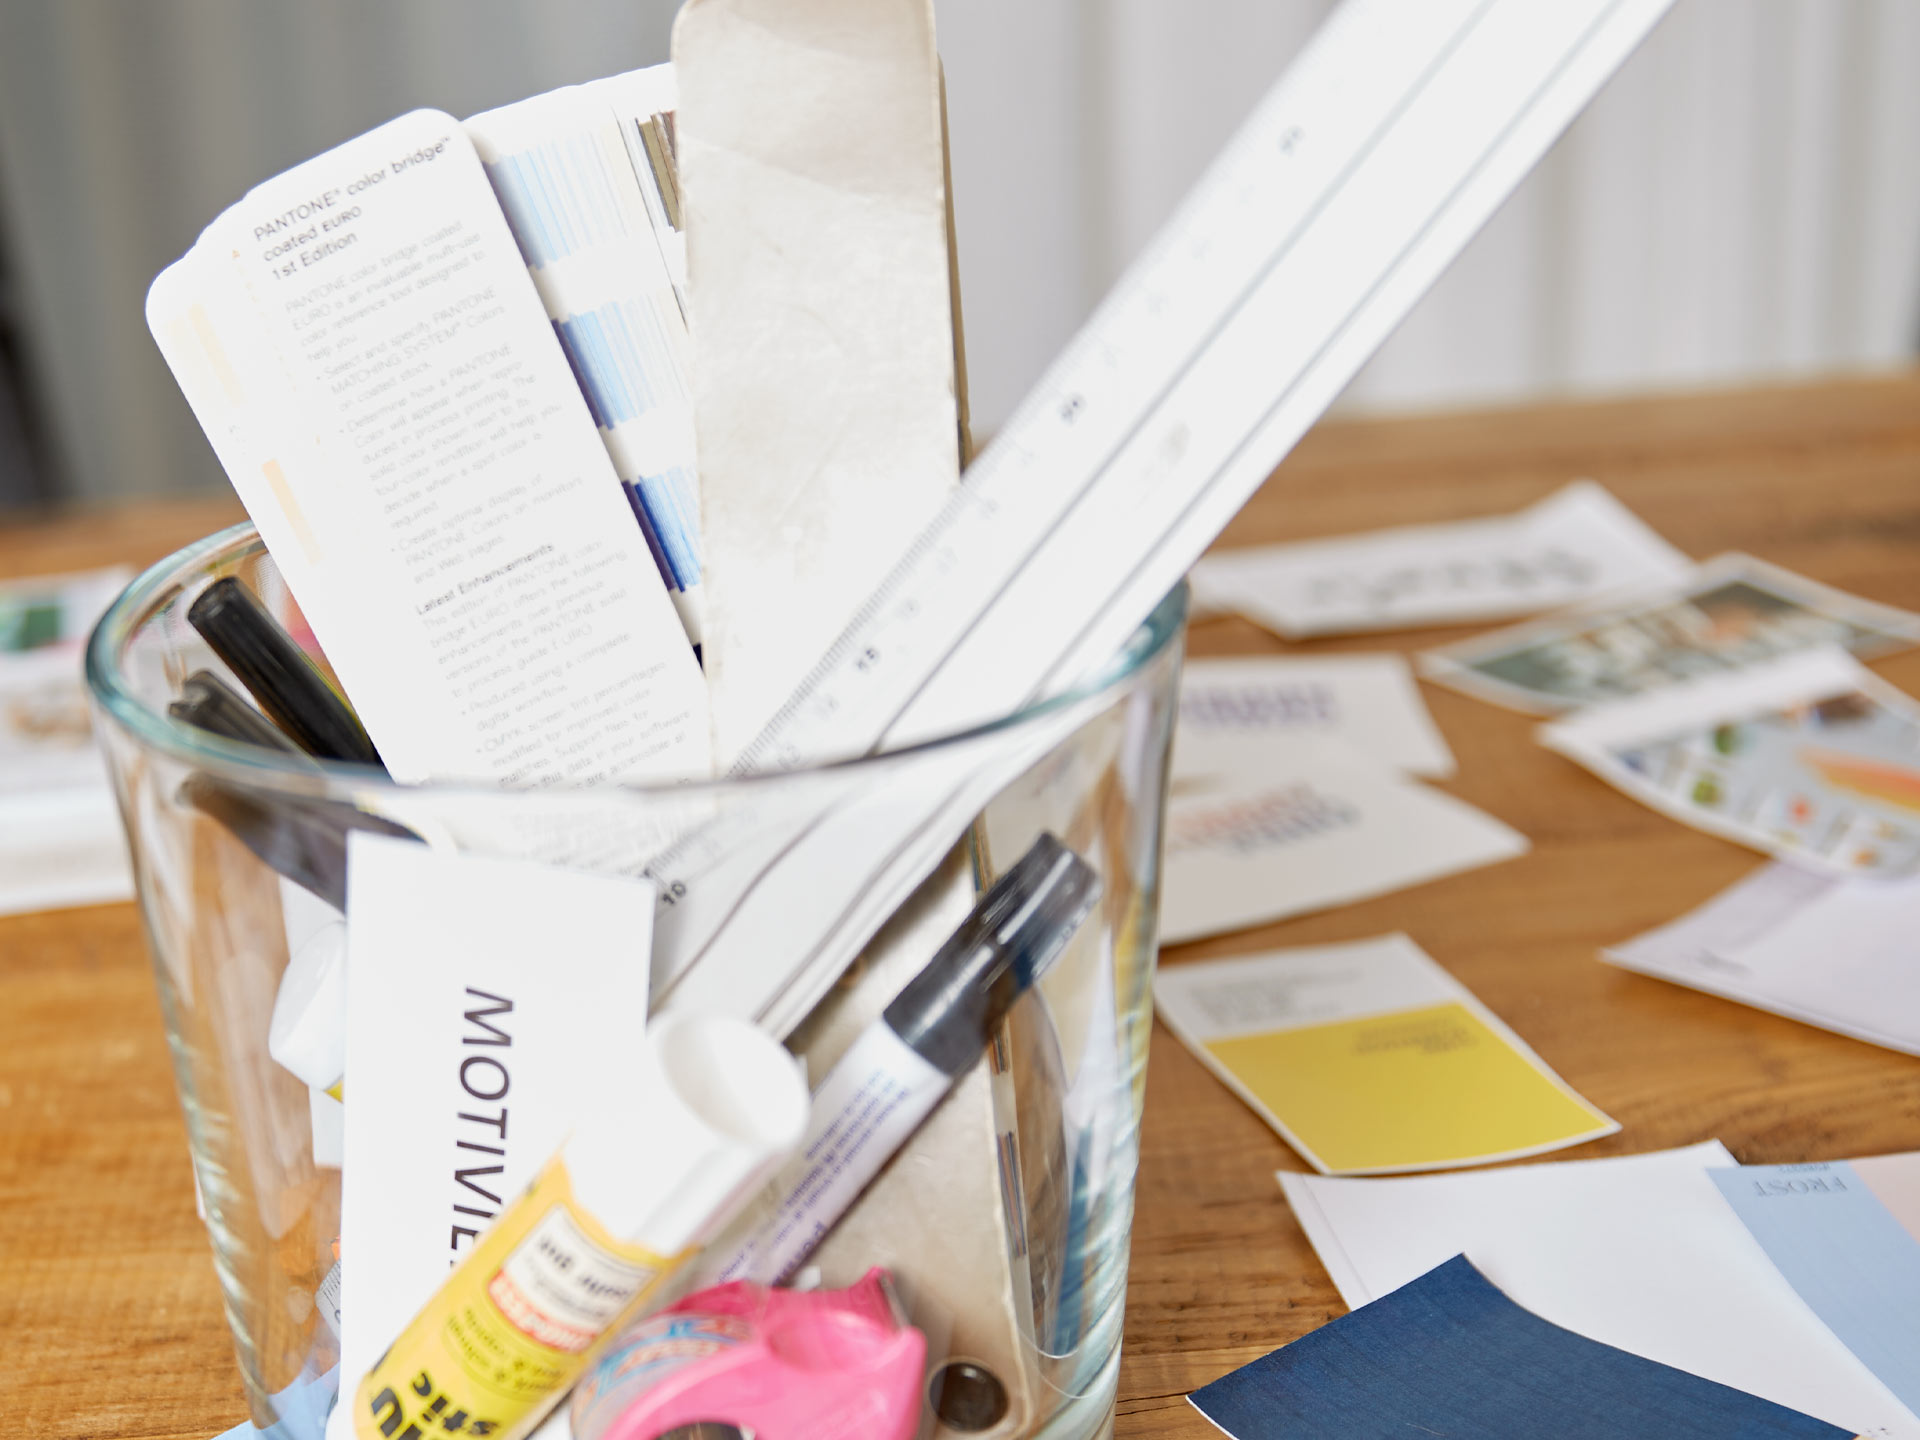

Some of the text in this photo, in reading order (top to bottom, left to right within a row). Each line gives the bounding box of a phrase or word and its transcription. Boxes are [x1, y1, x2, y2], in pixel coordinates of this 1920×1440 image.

[346, 168, 386, 195] color
[263, 205, 361, 261] coated EURO
[272, 232, 357, 279] 1st Edition
[284, 274, 346, 313] PANTONE
[432, 285, 496, 323] PANTONE
[291, 303, 330, 331] EURO
[330, 352, 402, 395] MATCHING
[448, 342, 512, 379] PANTONE
[416, 544, 554, 615] Latest Enhancements
[662, 879, 687, 906] 10
[450, 985, 513, 1267] MOTIVIE
[1753, 1176, 1848, 1197] FROST
[411, 1371, 499, 1438] stic
